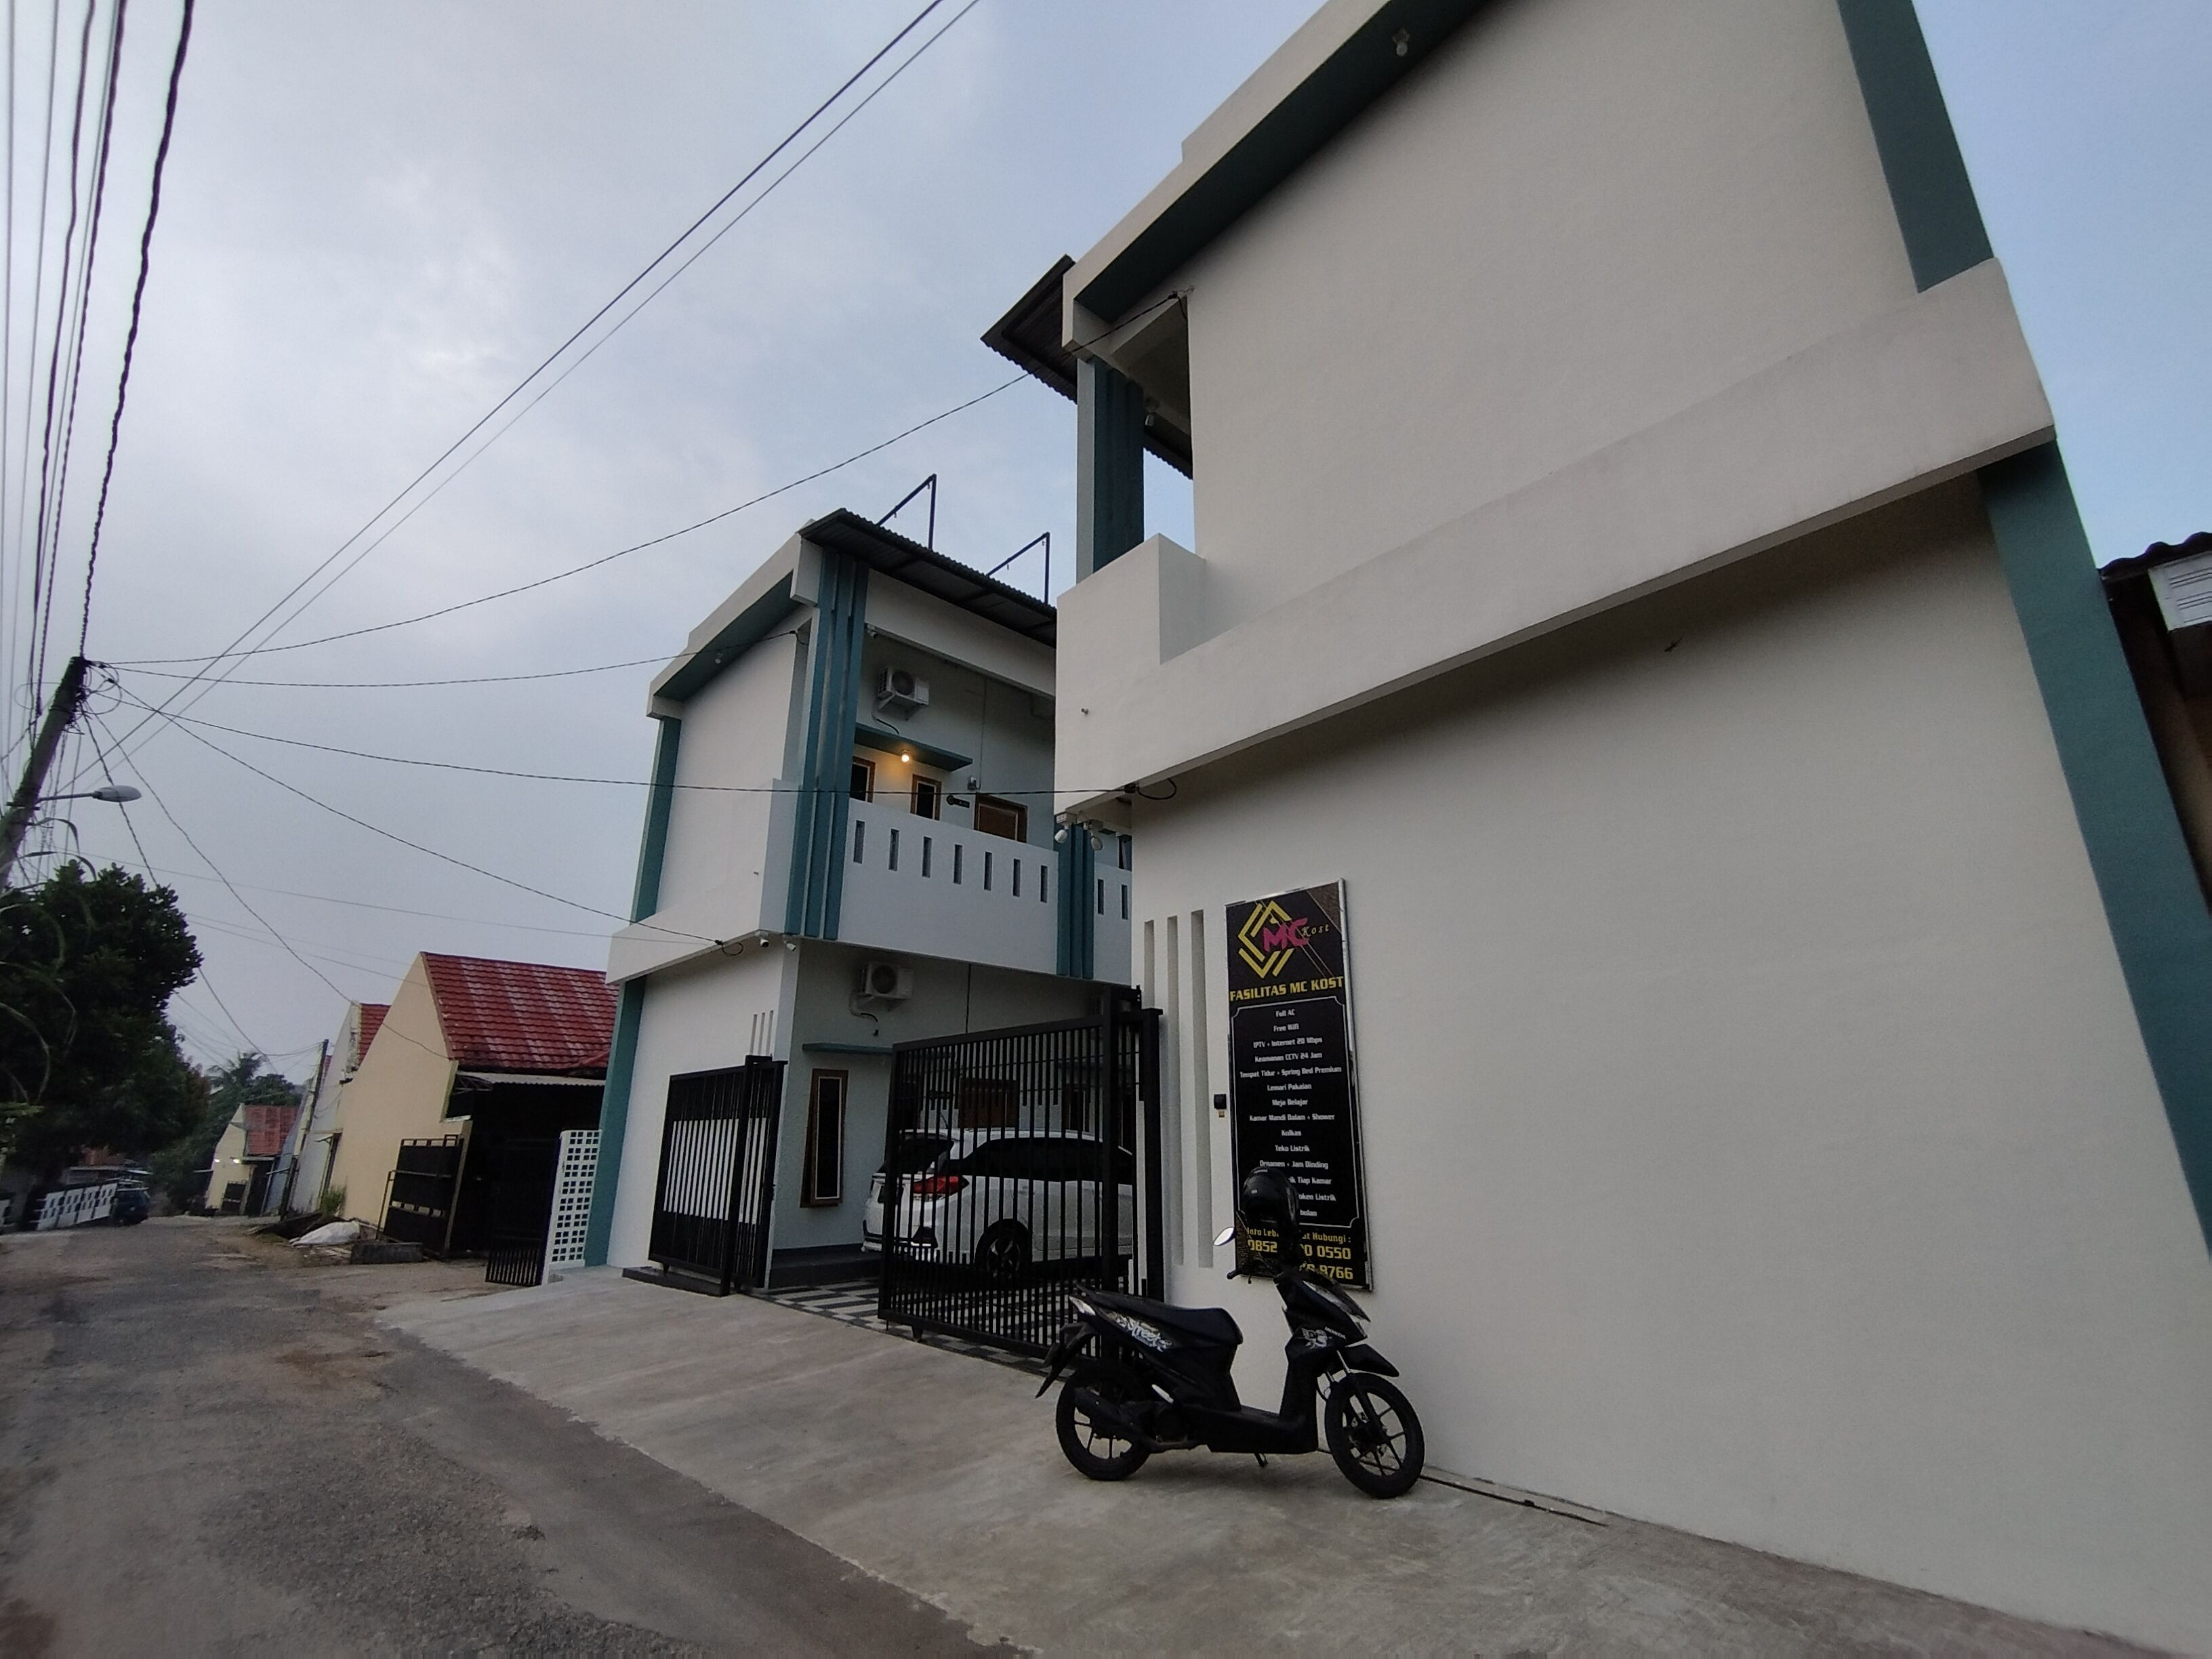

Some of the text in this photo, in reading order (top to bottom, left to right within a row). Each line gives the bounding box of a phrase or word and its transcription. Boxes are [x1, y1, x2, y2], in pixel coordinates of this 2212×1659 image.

[1263, 918, 1330, 951] MC Kost
[1230, 976, 1344, 1002] FASILITAS MC KOST
[1271, 1039, 1296, 1047] Internet
[1254, 1054, 1284, 1063] Keamanan
[1240, 1071, 1260, 1079] Tempat
[1281, 1068, 1300, 1076] Spring
[1272, 1099, 1308, 1107] Meja Belajar
[1305, 1161, 1329, 1170] Dinding
[1297, 1176, 1311, 1185] Tiap
[1311, 1176, 1332, 1185] Kamar
[1315, 1193, 1336, 1202] Listrik
[1312, 1232, 1346, 1244] Hubungi
[1317, 1246, 1351, 1260] 0550
